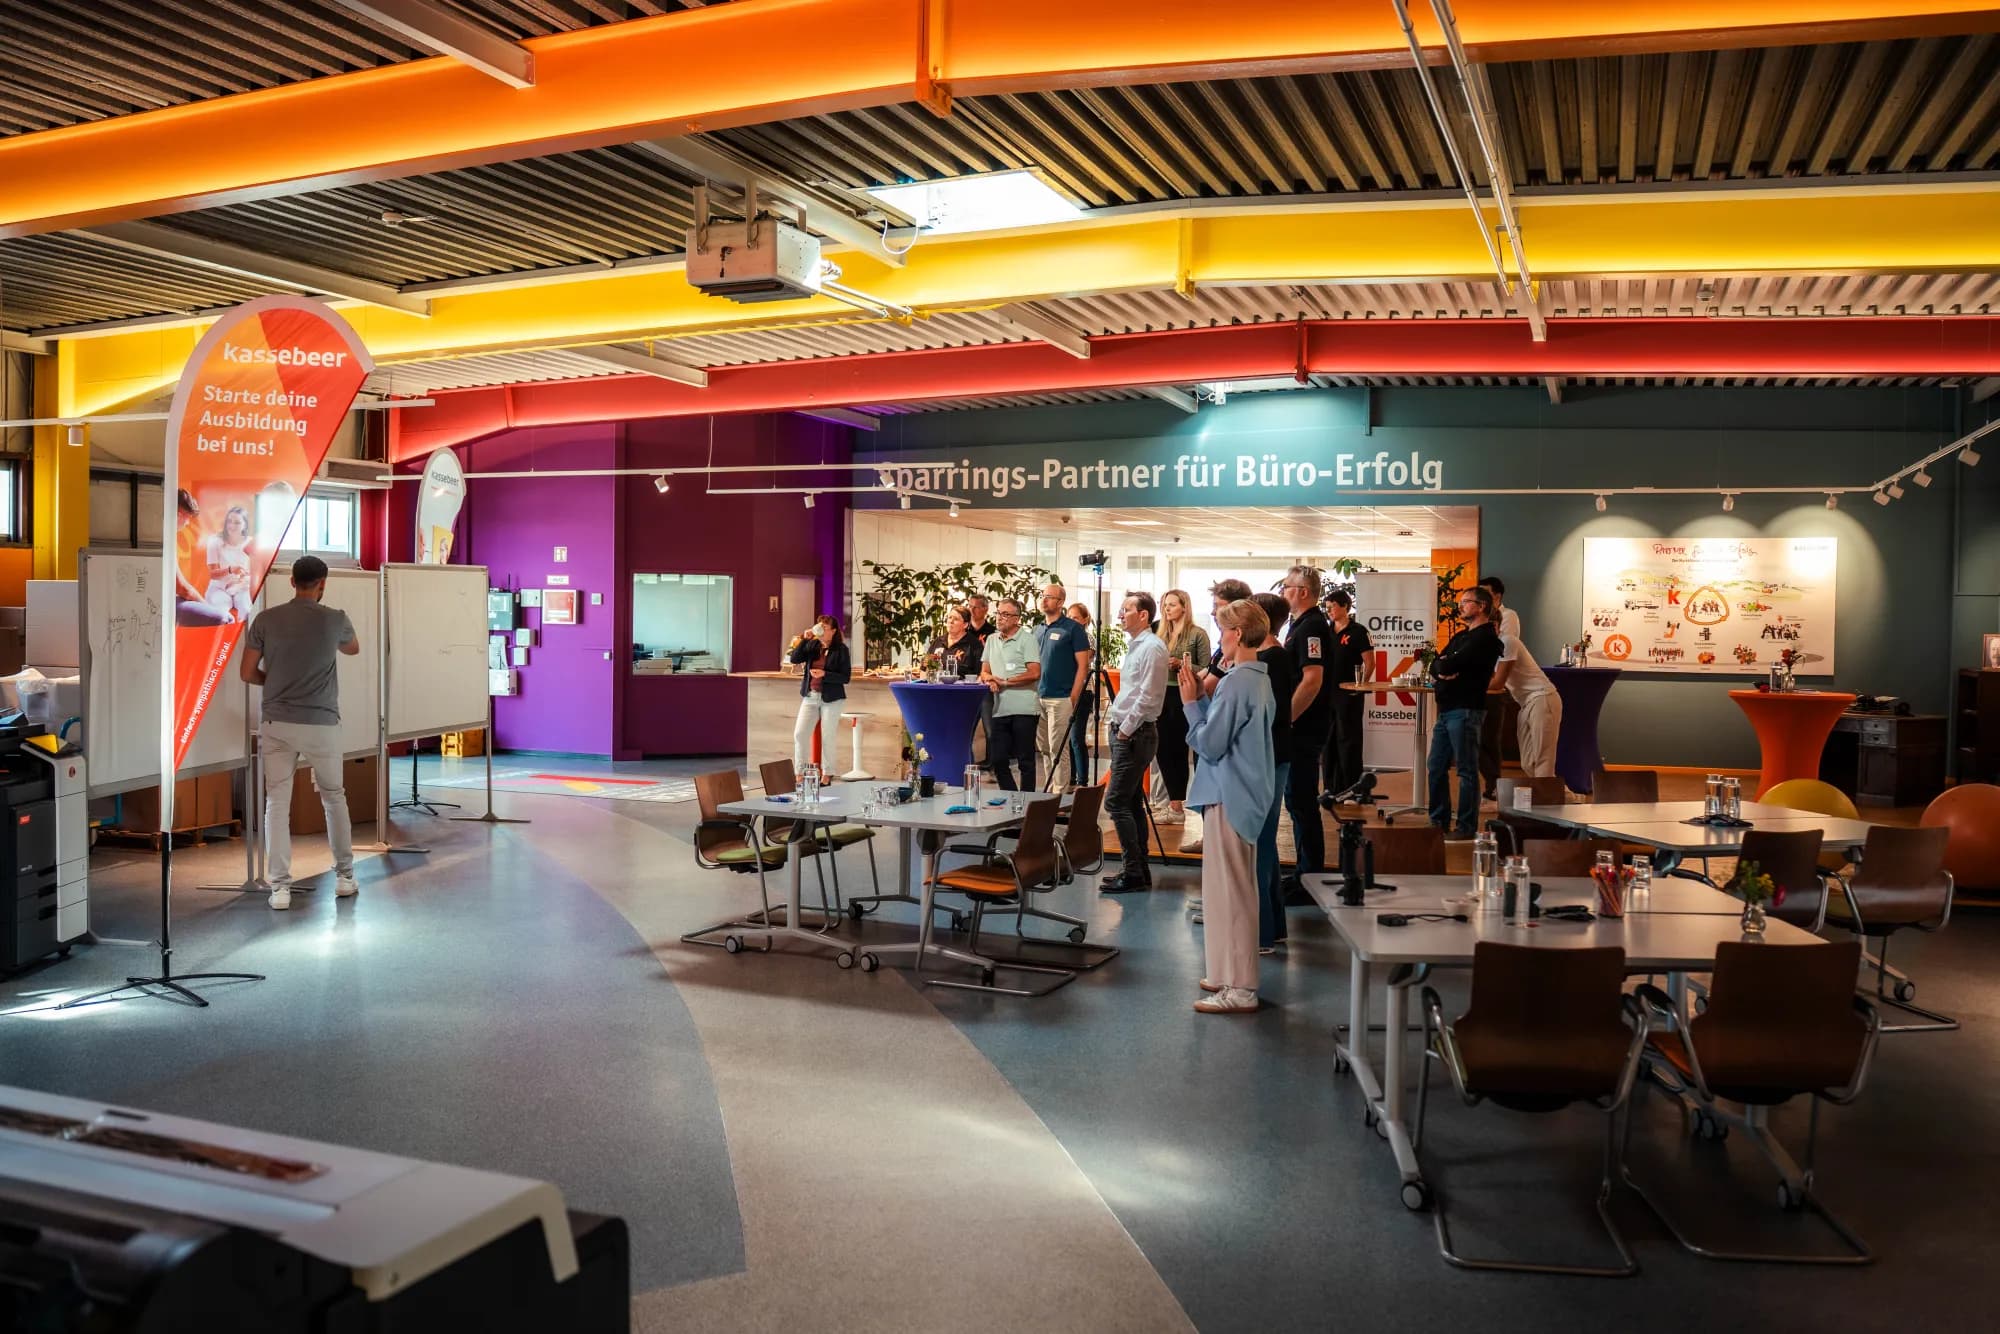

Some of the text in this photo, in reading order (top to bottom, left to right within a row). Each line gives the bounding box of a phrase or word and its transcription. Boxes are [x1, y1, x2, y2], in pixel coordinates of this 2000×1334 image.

[203, 384, 318, 408] Starte deine
[199, 411, 308, 437] Ausbildung
[197, 434, 274, 456] bei uns!
[879, 452, 1443, 498] parrings-Partner für Büro-Erfolg
[1368, 616, 1424, 631] Office
